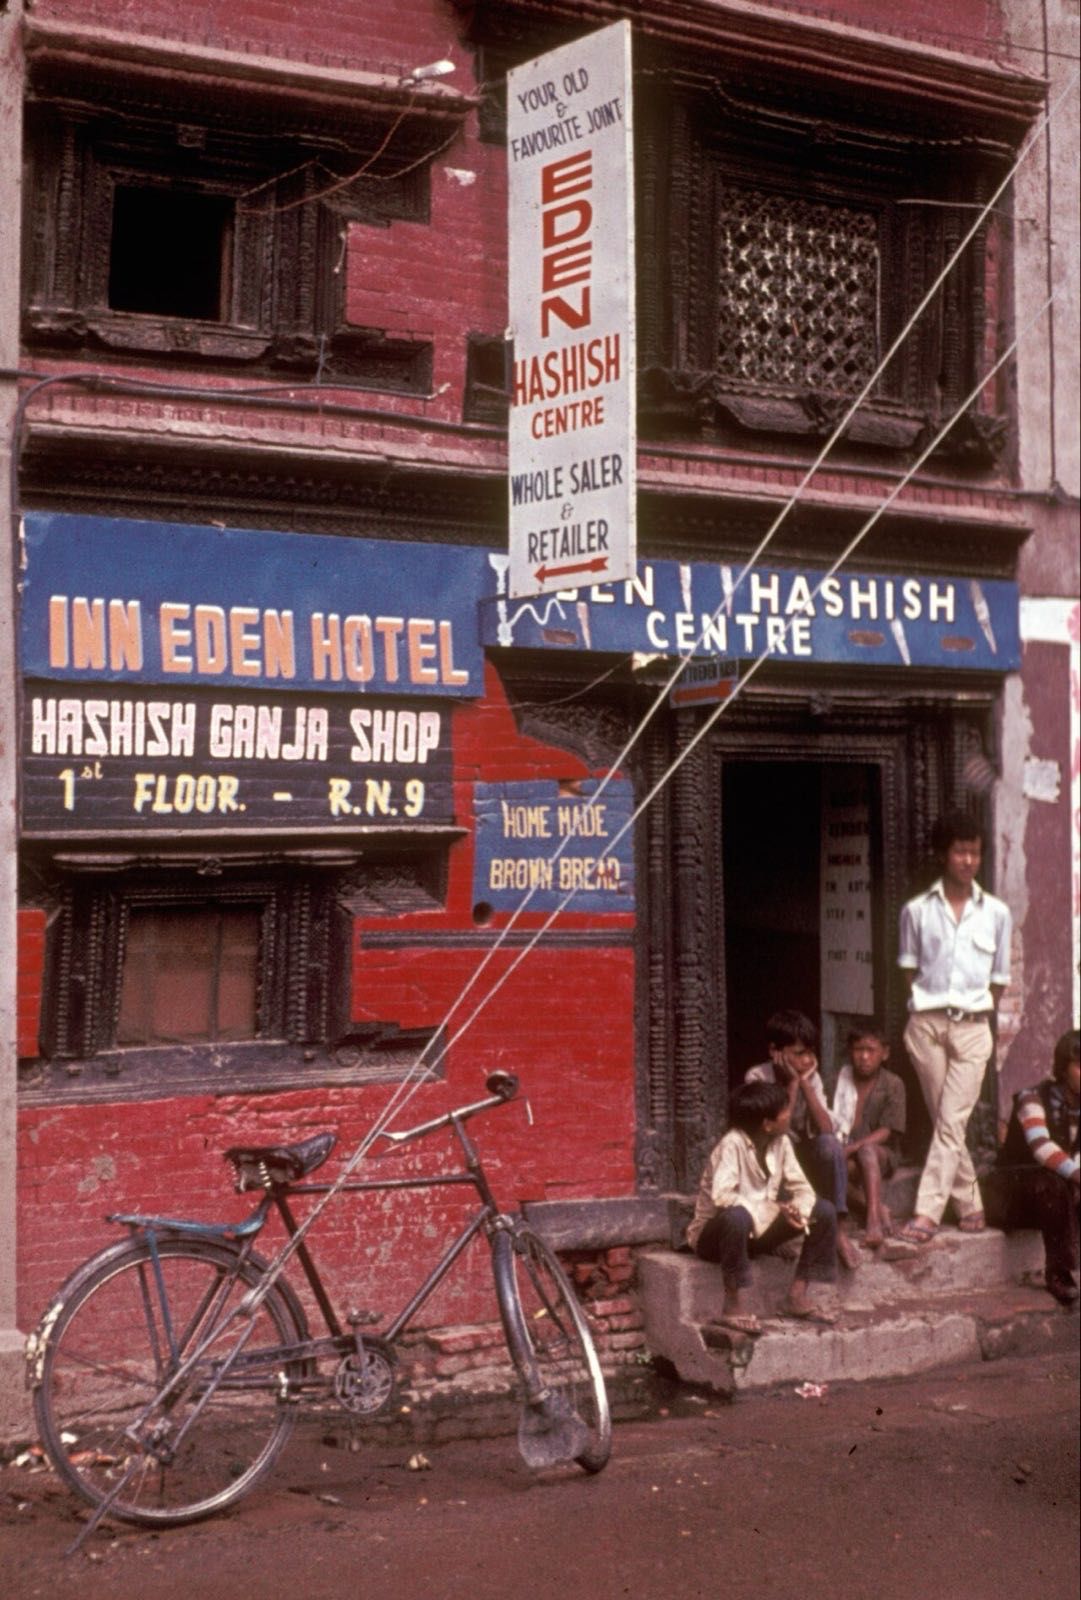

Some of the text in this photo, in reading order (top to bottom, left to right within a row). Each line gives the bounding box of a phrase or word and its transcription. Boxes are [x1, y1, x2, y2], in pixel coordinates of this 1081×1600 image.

[517, 67, 589, 114] YOUR OLD
[556, 103, 568, 118] &
[511, 97, 623, 162] FAVOURITE JOINT
[541, 149, 593, 339] EDEN
[511, 333, 620, 407] HASHISH
[531, 396, 604, 439] CENTRE
[511, 453, 623, 506] WHOLE SALER
[560, 503, 573, 520] &
[528, 518, 609, 563] RETAILER
[750, 572, 955, 623] HASHISH
[48, 595, 469, 686] INN EDEN HOTEL
[646, 610, 812, 656] CENTRE
[31, 698, 441, 763] HASHISH GANJA SHOP
[58, 762, 104, 812] 1st
[133, 773, 246, 814] FLOOR.
[328, 777, 425, 817] R.N.9
[501, 800, 608, 838] HOME MADE
[489, 857, 620, 891] BROWN BREAD
